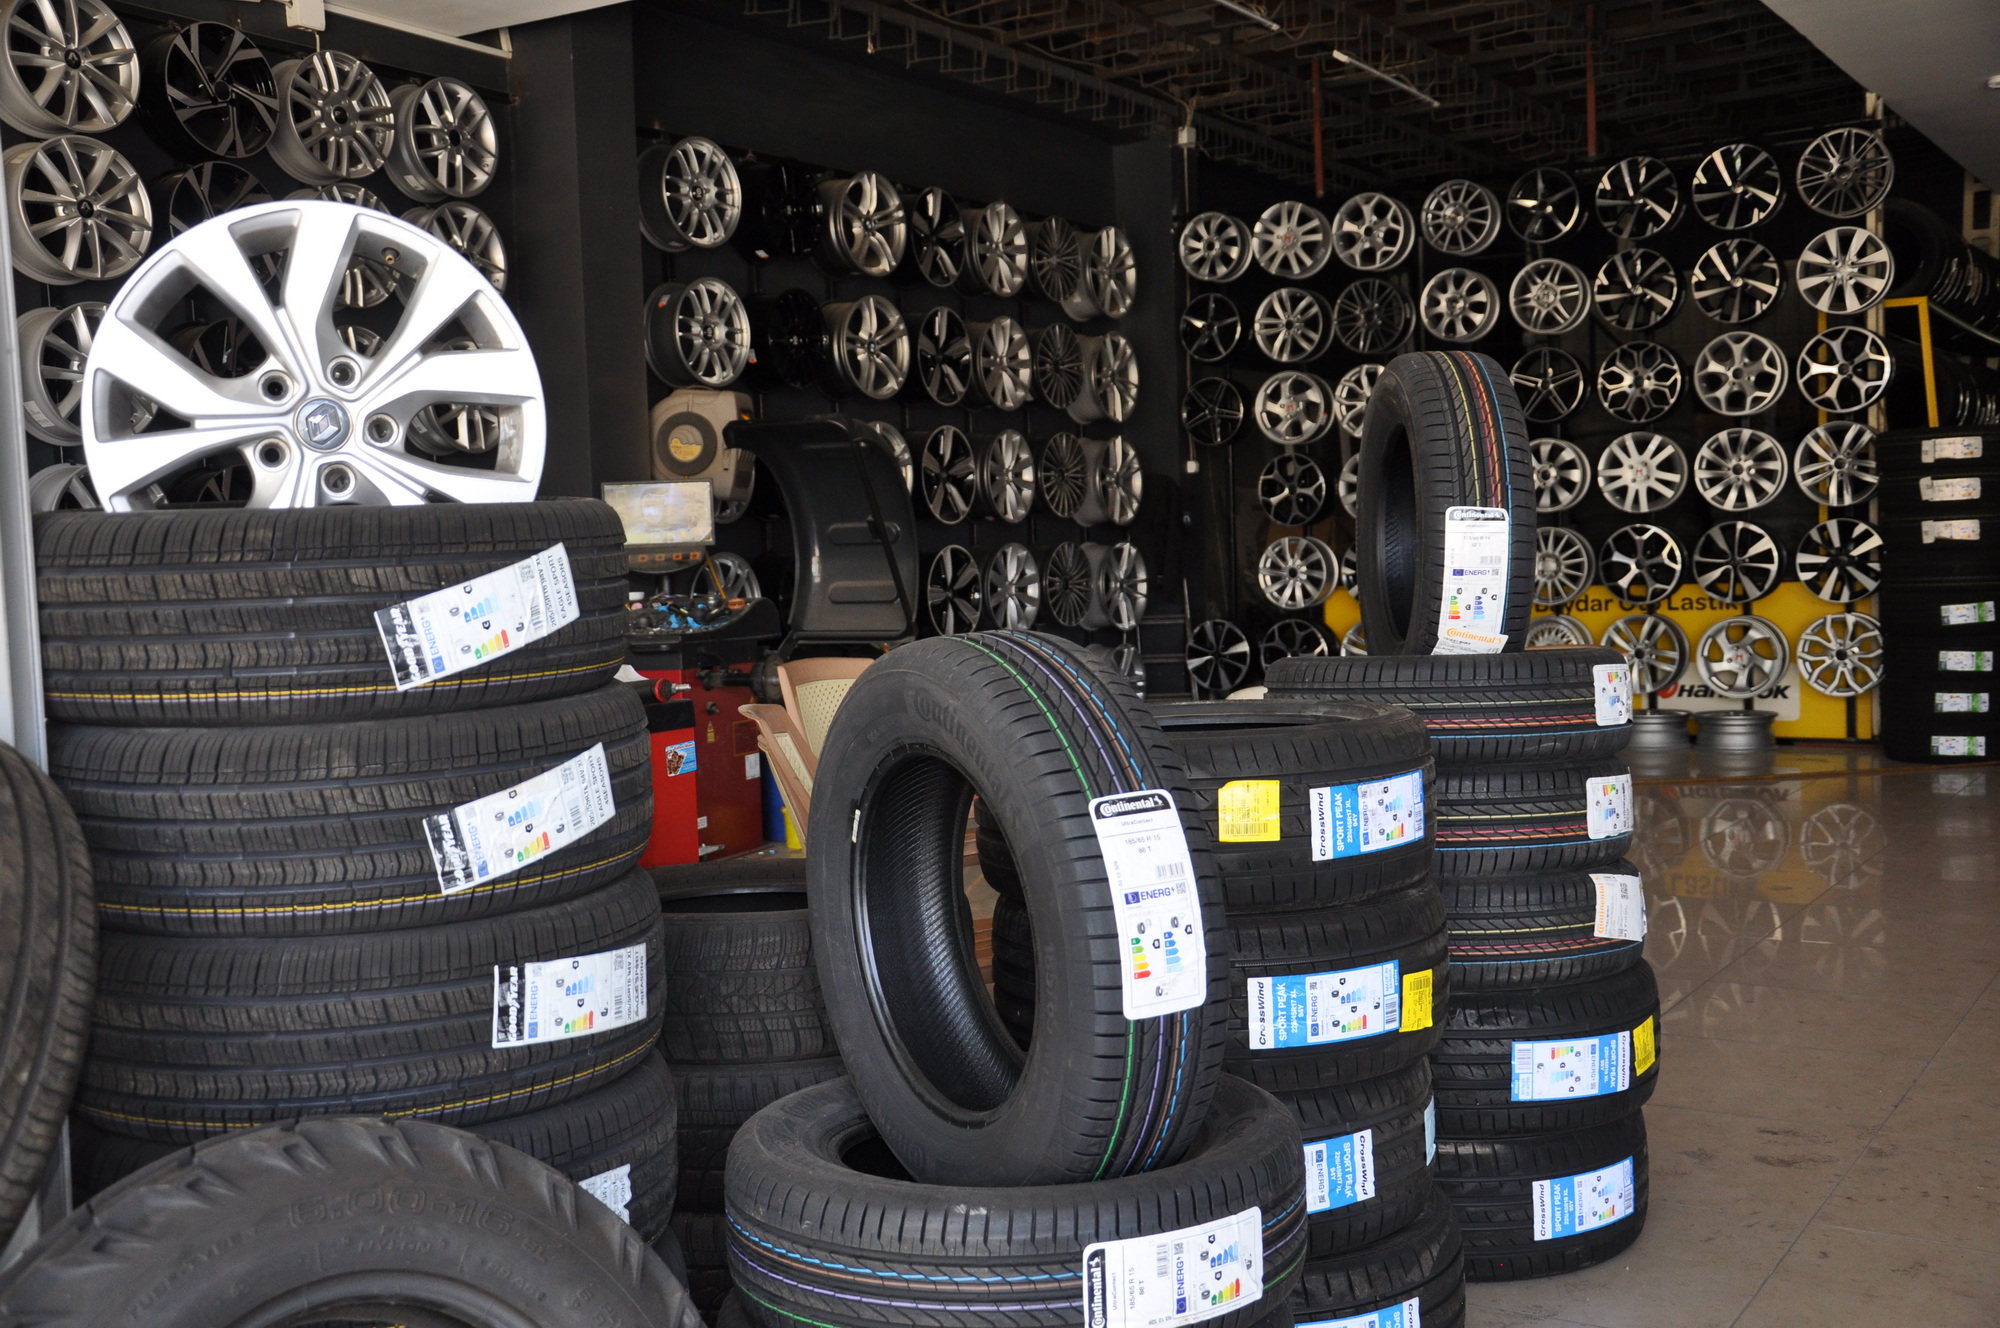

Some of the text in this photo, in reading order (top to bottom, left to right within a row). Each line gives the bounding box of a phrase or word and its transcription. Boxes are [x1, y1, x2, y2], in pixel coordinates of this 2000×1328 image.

[1454, 510, 1494, 519] Continental
[547, 554, 566, 620] EAGLE SPORT
[557, 557, 572, 607] 4SEASONS
[1535, 595, 1613, 614] Bydar
[422, 620, 439, 656] ENERG
[1446, 628, 1496, 644] Continental
[1677, 683, 1790, 698] Hanok
[588, 755, 598, 786] SPORT
[597, 756, 608, 805] 4SEASONS
[1100, 796, 1154, 817] Continental
[1317, 792, 1326, 856] CrossWind
[1334, 792, 1344, 851] SPORT PEAK
[1140, 888, 1170, 900] ENERG
[508, 966, 520, 1042] GOODYEAR
[530, 984, 538, 1020] ENERG
[1276, 982, 1287, 1040] SPORT PEAK
[1316, 1164, 1324, 1192] ENERG
[1343, 1142, 1354, 1198] SPORT PEAK
[1360, 1135, 1368, 1196] CrossWind
[1129, 1268, 1134, 1276] 15
[1176, 1260, 1184, 1296] ENERG
[1090, 1267, 1106, 1328] Continental
